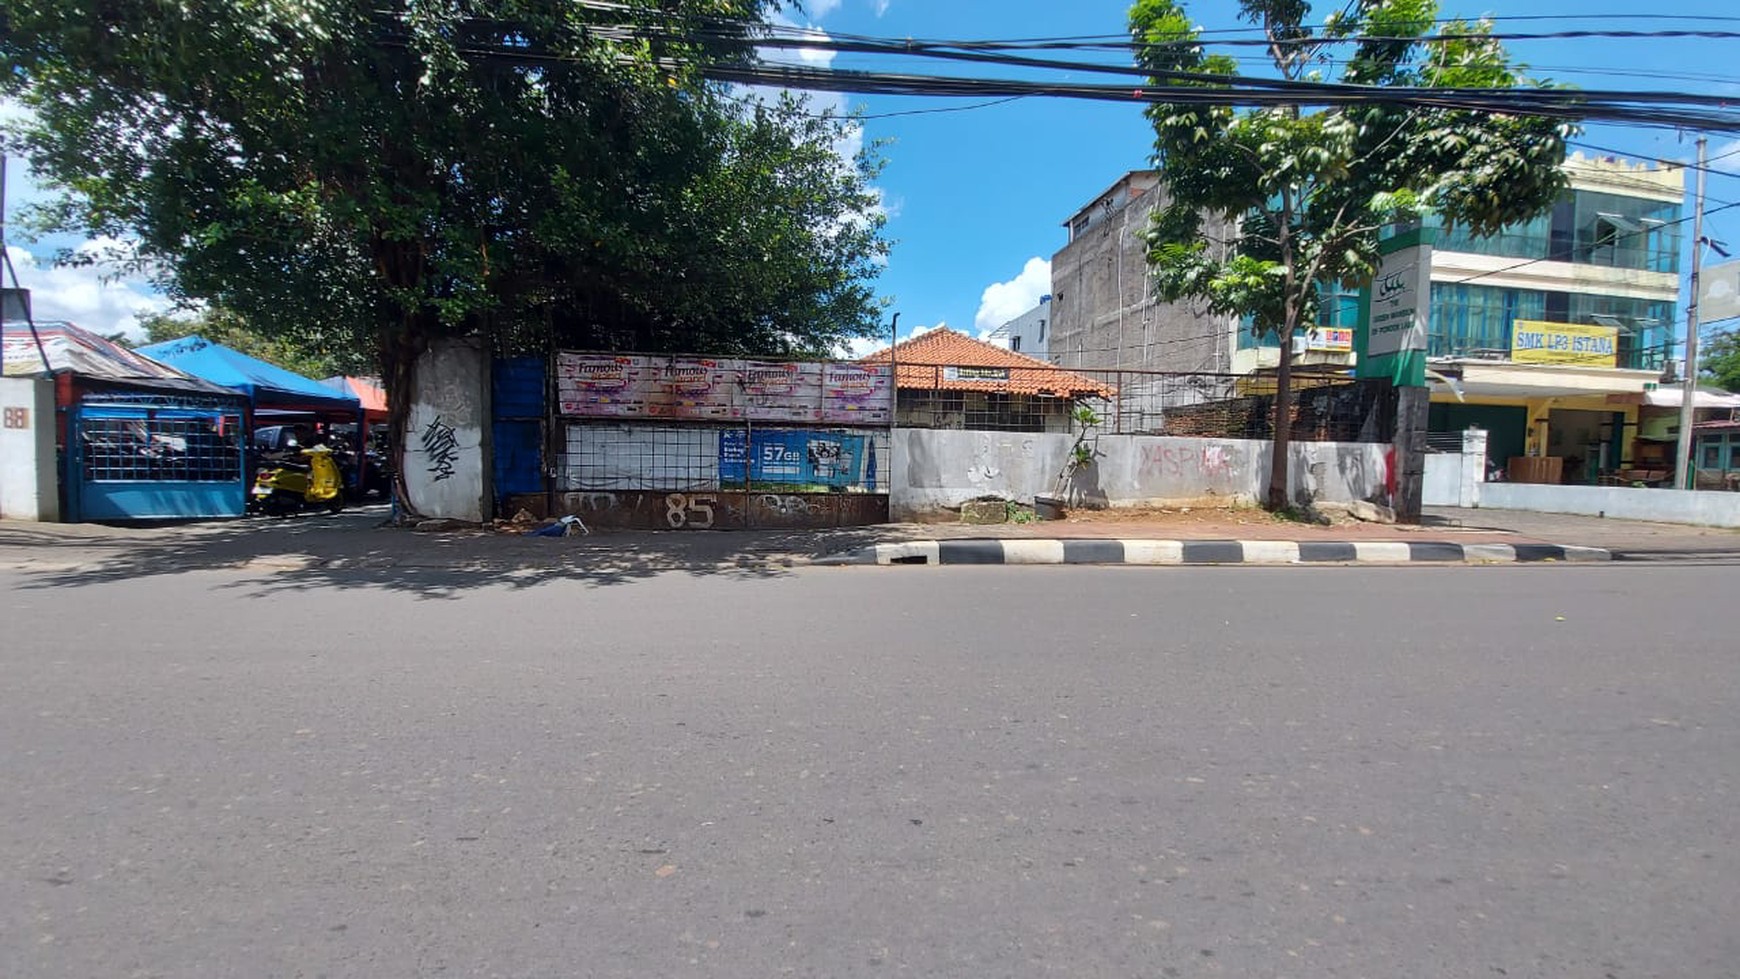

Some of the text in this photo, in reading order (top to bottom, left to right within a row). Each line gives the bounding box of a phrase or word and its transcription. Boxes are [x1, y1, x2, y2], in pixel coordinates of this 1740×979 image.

[1518, 332, 1544, 348] SMK
[1573, 336, 1613, 354] ISTANA
[579, 362, 624, 374] Famous
[665, 364, 708, 377] Famous
[666, 494, 717, 528] 85
